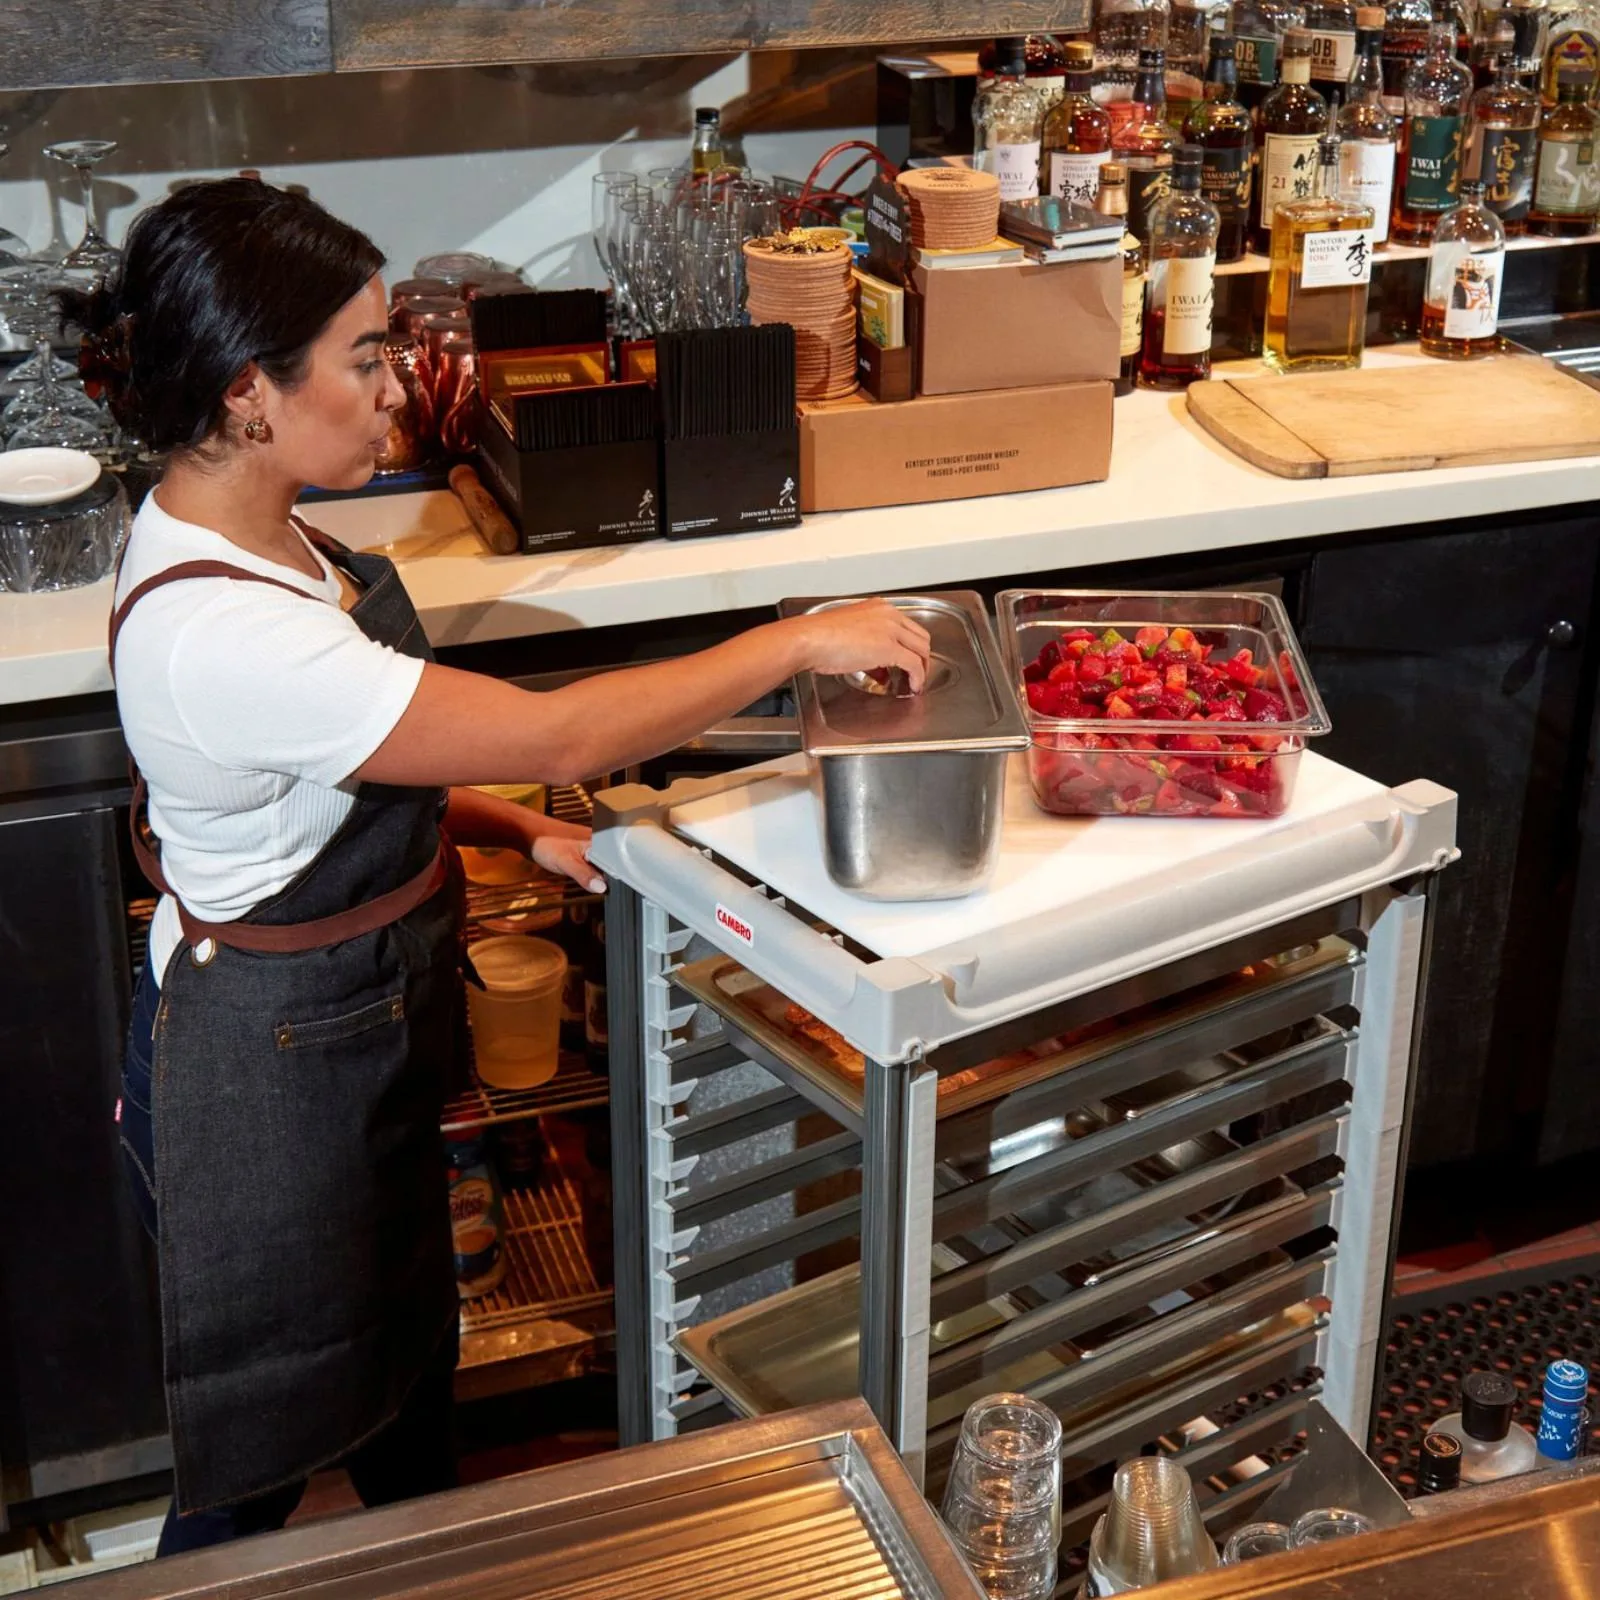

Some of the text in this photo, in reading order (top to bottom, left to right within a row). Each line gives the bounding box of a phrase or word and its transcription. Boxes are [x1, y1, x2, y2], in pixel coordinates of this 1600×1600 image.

[1410, 157, 1441, 170] IWAI
[1271, 176, 1286, 189] 21
[1059, 179, 1099, 203] 宮城
[1310, 237, 1347, 246] SUNTORY
[1309, 245, 1341, 254] WHISKY
[1345, 233, 1370, 277] 季
[1172, 295, 1201, 305] IWAI
[905, 449, 1019, 469] KENTUCKY STRAIGHT BOURBON WHISKEY
[927, 462, 1000, 478] FINISHED PORT BARRELS
[717, 909, 752, 941] CAMBRO
